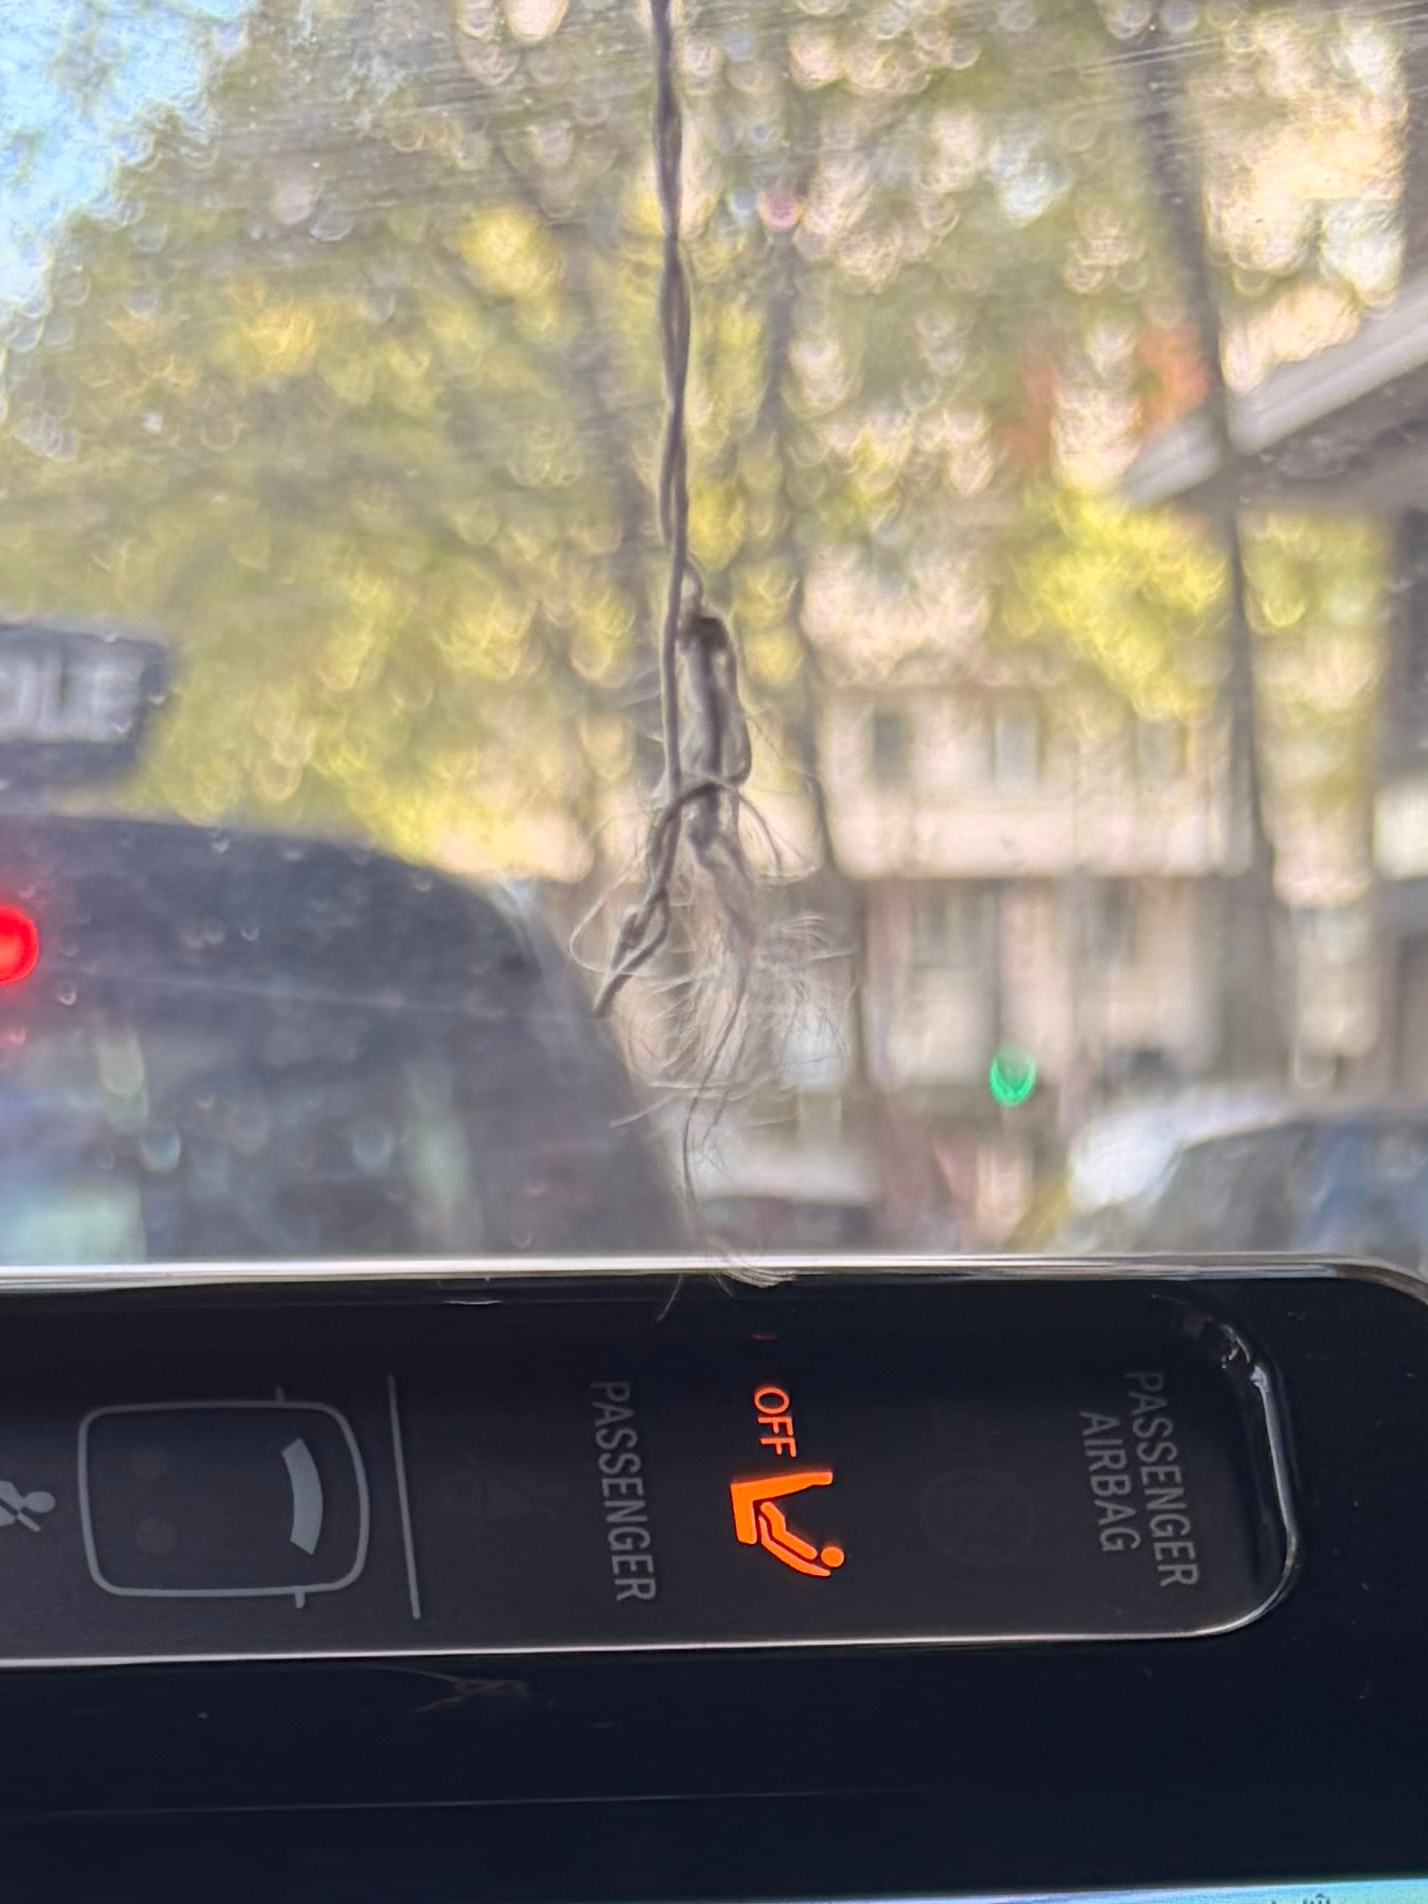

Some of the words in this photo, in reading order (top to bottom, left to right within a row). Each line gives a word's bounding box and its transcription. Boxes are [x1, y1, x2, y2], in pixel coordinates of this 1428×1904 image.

[591, 1381, 657, 1602] PASSENGER
[754, 1386, 797, 1458] OFF
[1079, 1411, 1142, 1554] AIRBAG
[1125, 1371, 1200, 1588] PASSENGER
